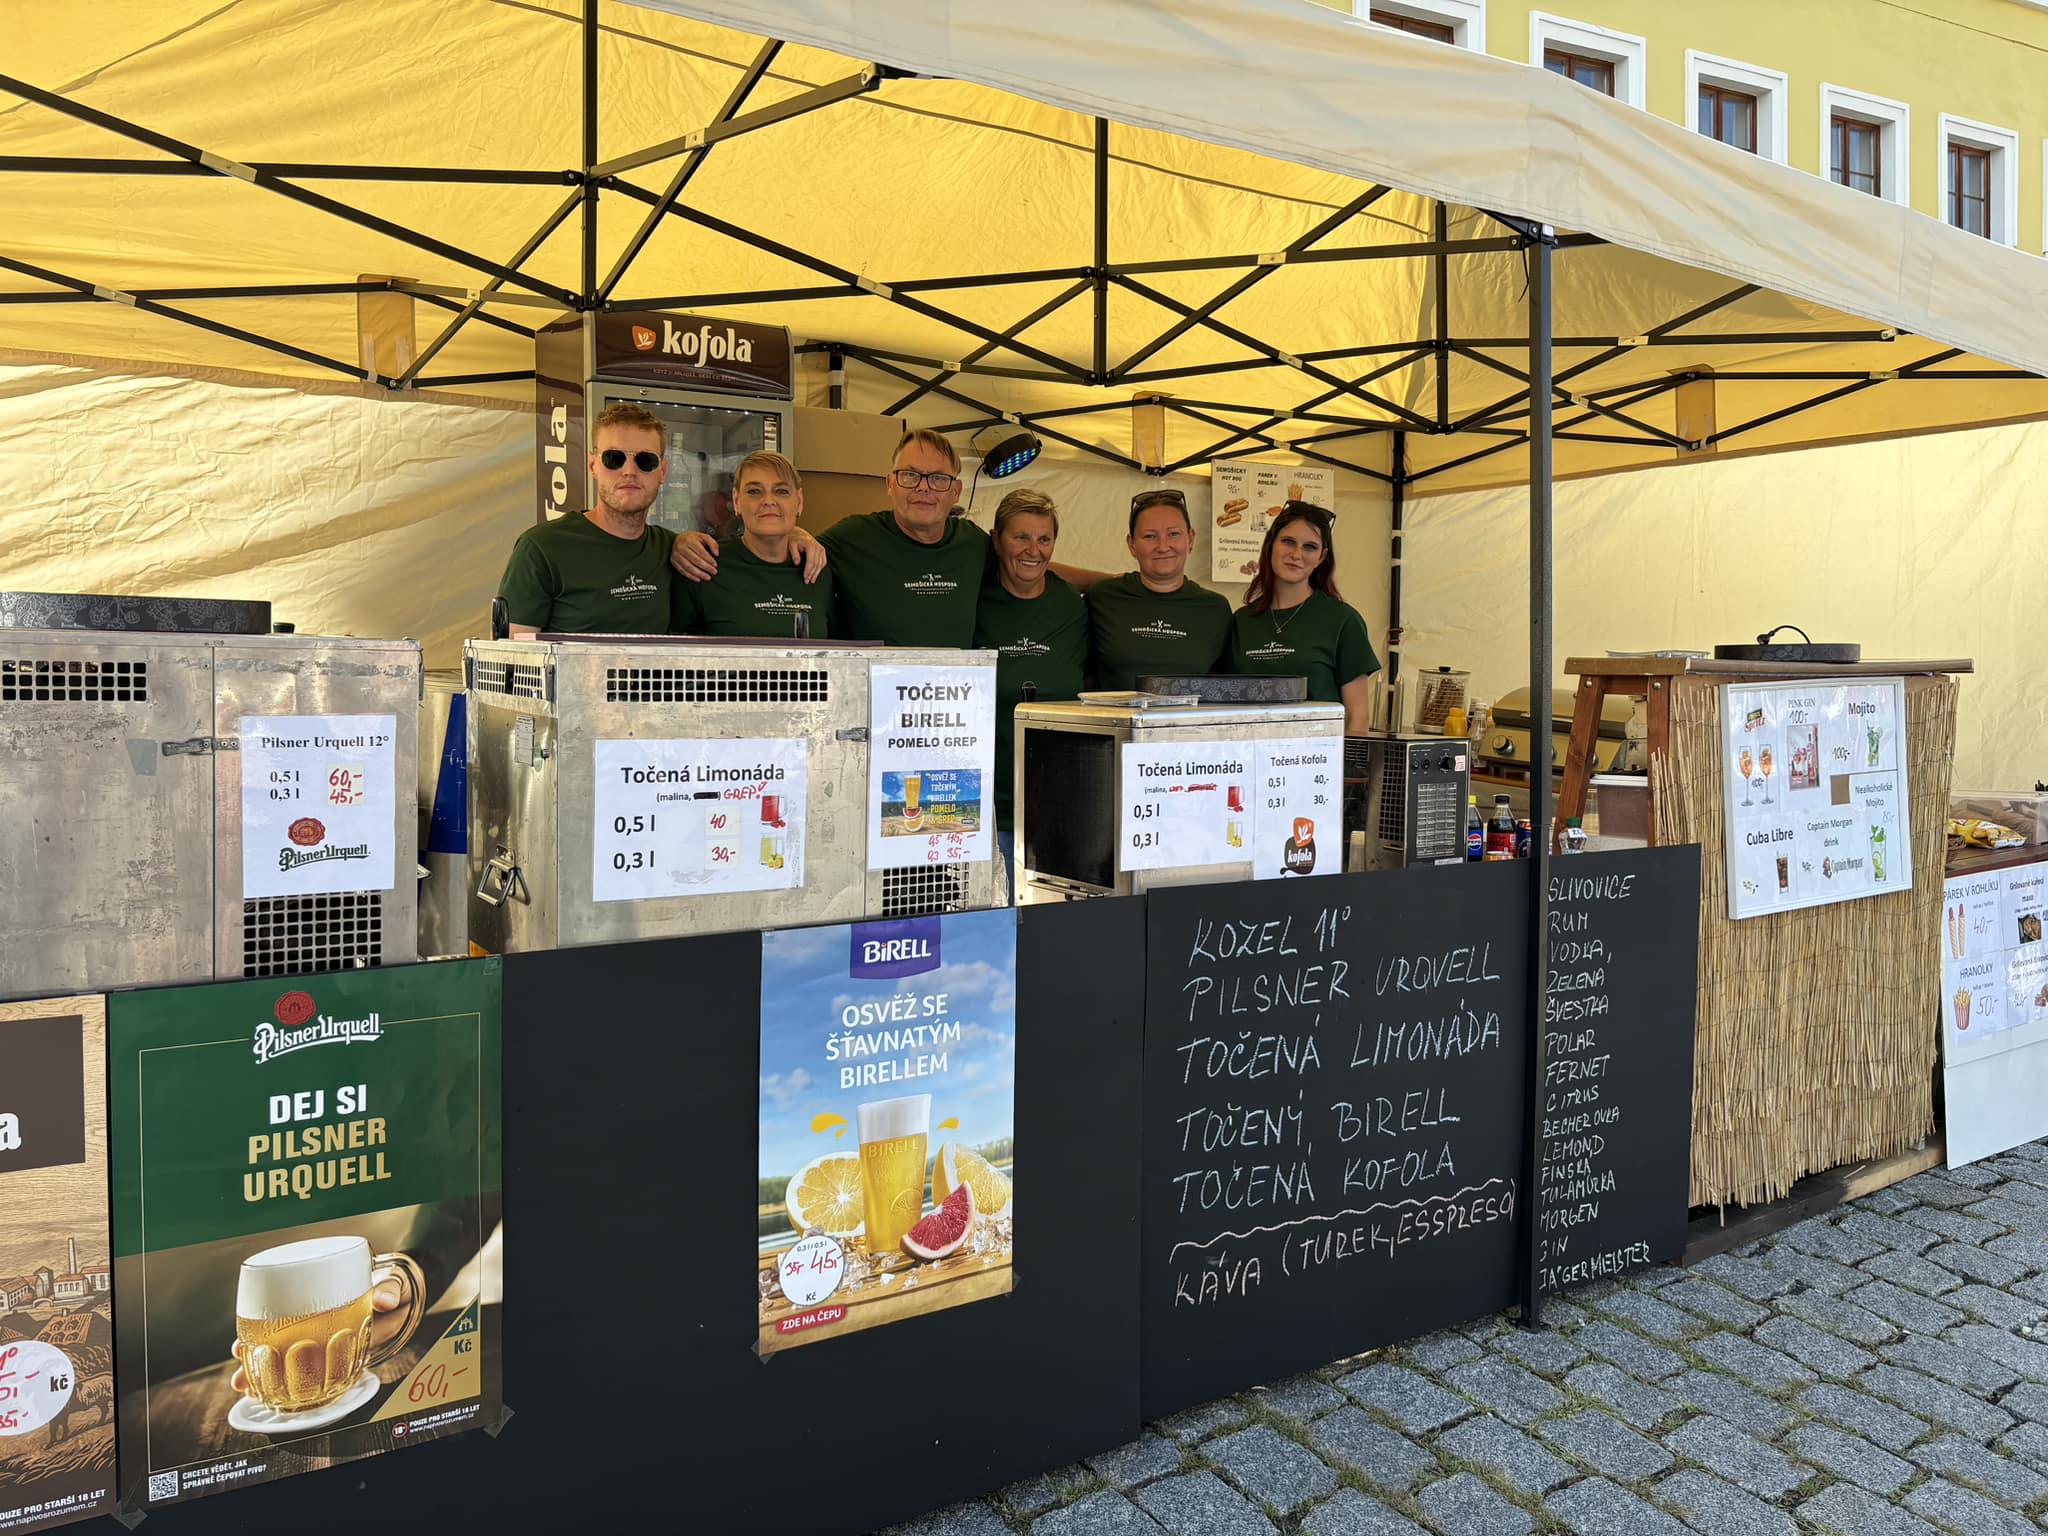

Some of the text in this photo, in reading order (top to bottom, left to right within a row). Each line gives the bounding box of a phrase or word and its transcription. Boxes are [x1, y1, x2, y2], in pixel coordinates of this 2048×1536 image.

[662, 320, 752, 368] kofola
[896, 682, 972, 701] TOČENÝ
[1804, 698, 1816, 707] GIN
[901, 713, 966, 728] BIRELL
[1848, 703, 1876, 717] Mojito
[262, 735, 389, 750] Pilsner Urquell 12°
[888, 736, 977, 749] POMELO GREP
[1137, 760, 1243, 777] Točená Limonáda
[1270, 754, 1327, 767] Točená Kofola
[270, 771, 291, 783] 0,5
[329, 768, 363, 788] 60,-
[621, 764, 784, 784] Točená Limonáda
[1268, 777, 1281, 789] 0,5
[1313, 774, 1330, 785] 40,-
[270, 788, 290, 801] 0,3
[329, 789, 363, 804] 45,-
[657, 791, 692, 802] (malina,
[1268, 798, 1281, 809] 0,3
[1313, 794, 1329, 806] 30,-
[1865, 799, 1884, 809] Mojito
[1134, 804, 1152, 820] 0,5
[614, 816, 644, 836] 0,5
[710, 814, 727, 829] 40
[1807, 818, 1853, 832] Captain Morgan
[1133, 833, 1152, 849] 0,3
[1746, 828, 1794, 846] Cuba Libre
[1824, 837, 1839, 847] drink
[279, 844, 368, 872] Pilsner Urquell
[613, 851, 643, 872] 0,3
[711, 847, 737, 862] 30,-
[1287, 848, 1312, 866] kofola
[1548, 874, 1636, 902] SLIVOVICE
[1965, 886, 1970, 896] V
[1971, 880, 1999, 896] ROHLÍKU
[1548, 911, 1588, 933] RUM
[1188, 915, 1298, 968] KOZEL
[1960, 962, 1993, 979] HRANOLKY
[1182, 960, 1350, 1022] PILSNER
[842, 992, 949, 1028] OSVĚŽ SE
[1545, 995, 1609, 1022] ŠVESTKA
[253, 1013, 380, 1064] Pilsner Urquell
[826, 1018, 961, 1061] ŠŤAVNATÝM
[1177, 998, 1500, 1084] TOČENÁ LIMONÁDA
[1545, 1029, 1595, 1056] POLAR
[840, 1052, 949, 1089] BIRELLEM
[1545, 1054, 1610, 1087] FERNET
[270, 1084, 367, 1125] DEJ SI
[1177, 1087, 1461, 1151] TOČENÝ BIRELL
[249, 1117, 386, 1164] PILSNER
[868, 1138, 919, 1158] BIRELL
[243, 1152, 391, 1202] URQUELL
[1173, 1141, 1455, 1213] TOČENÁ KOFOLA
[1540, 1201, 1599, 1232] MORGEN
[1175, 1251, 1261, 1306] KÁVA
[782, 1308, 841, 1330] ZDE NA ČEPU
[454, 1339, 472, 1354] Kč
[50, 1374, 68, 1392] kč
[408, 1364, 468, 1402] 60,-
[409, 1420, 428, 1429] POUZE
[428, 1416, 440, 1424] PRO
[441, 1409, 461, 1420] STARŠÍ
[470, 1404, 480, 1412] LET
[182, 1468, 209, 1480] CHCETE
[234, 1459, 248, 1469] JAK
[182, 1464, 267, 1490] SPRÁVNĚ ČEPOVAT PIVO?
[24, 1503, 42, 1515] PRO
[44, 1494, 75, 1511] STARŠÍ
[78, 1493, 89, 1502] 18
[90, 1489, 106, 1500] LET
